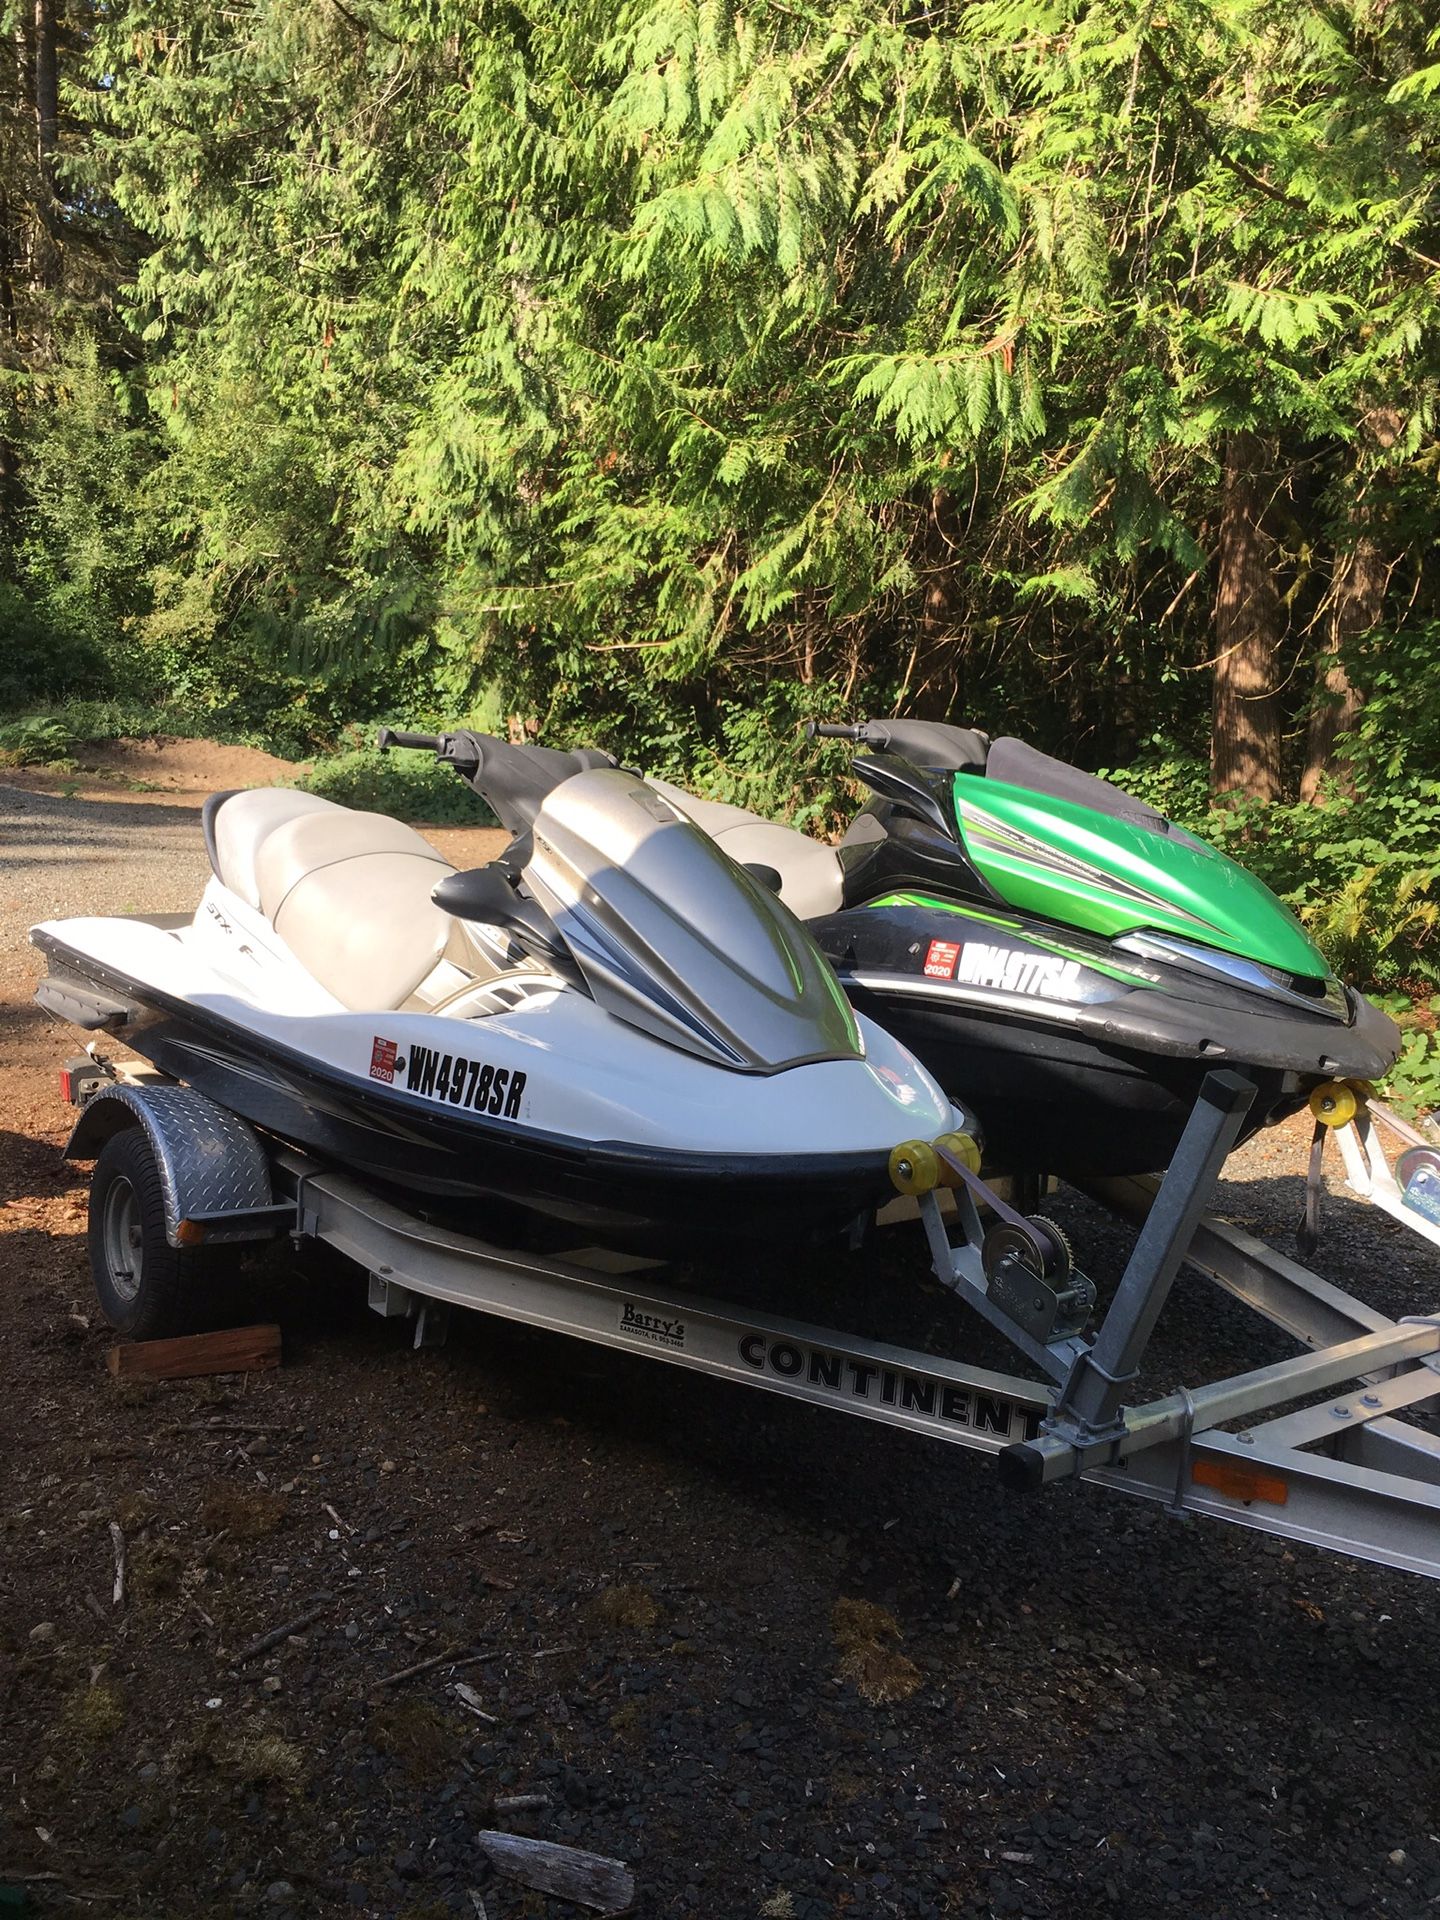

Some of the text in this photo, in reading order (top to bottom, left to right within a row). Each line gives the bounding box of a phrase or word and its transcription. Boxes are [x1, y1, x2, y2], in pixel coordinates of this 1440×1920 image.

[926, 963, 951, 977] 2020
[370, 1065, 393, 1082] 2020
[406, 1044, 528, 1120] WN4978SR
[622, 1302, 685, 1336] Barry's
[737, 1333, 1048, 1444] CONTINENT
